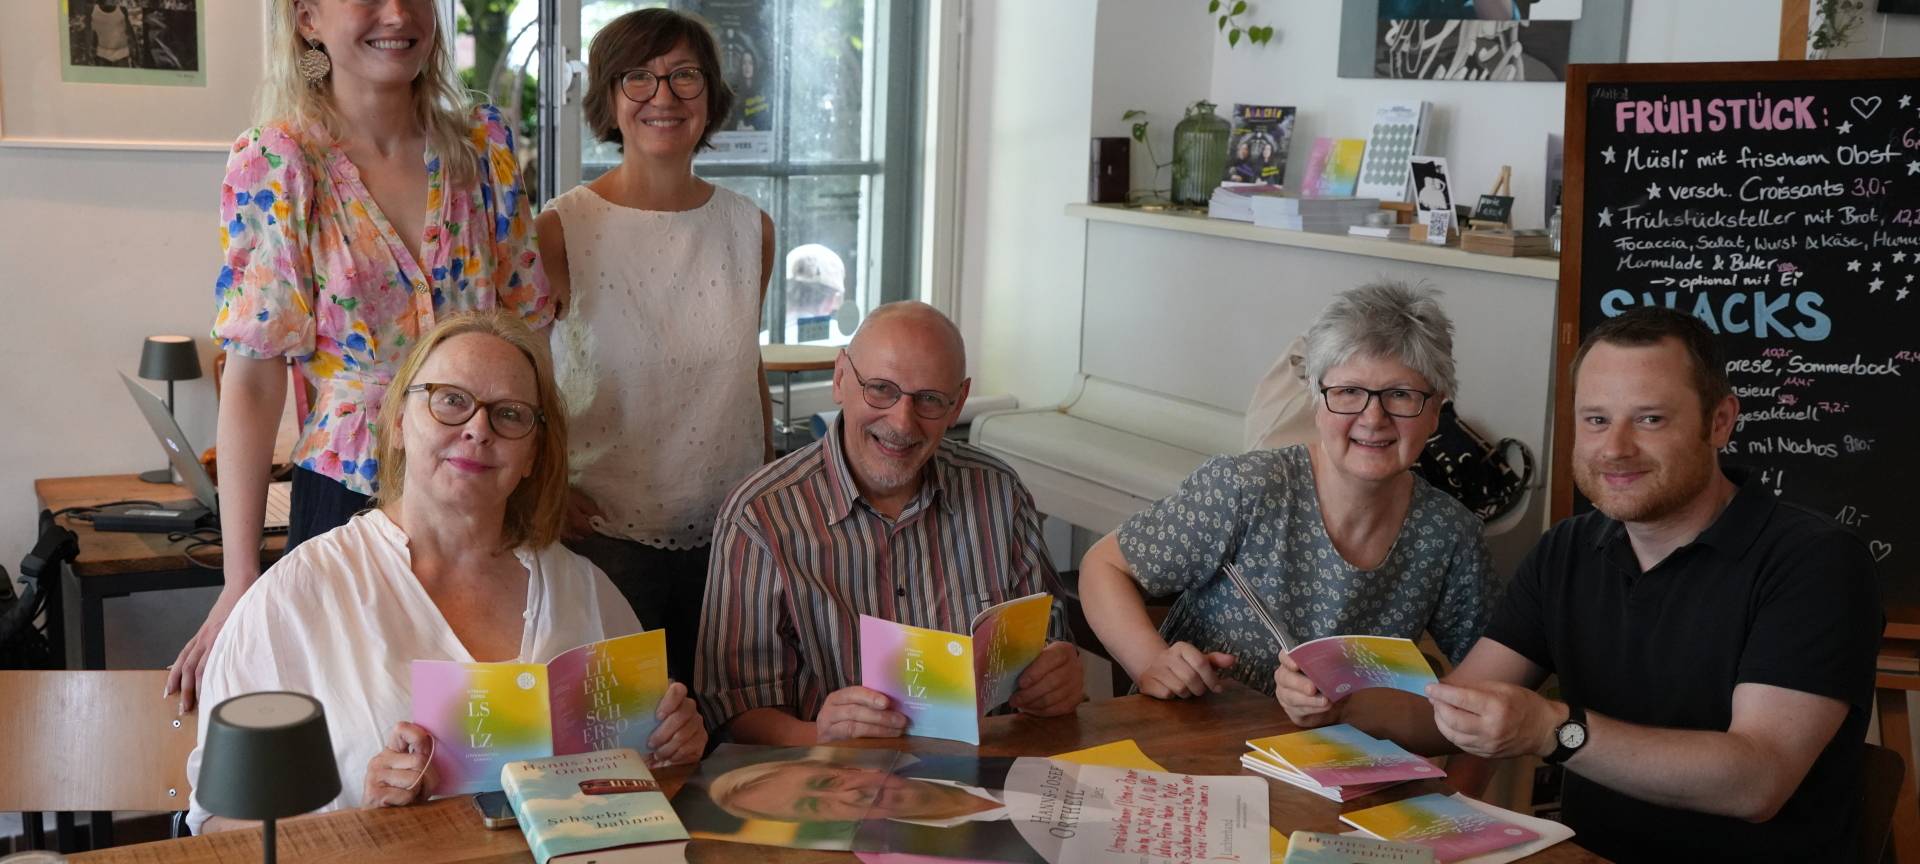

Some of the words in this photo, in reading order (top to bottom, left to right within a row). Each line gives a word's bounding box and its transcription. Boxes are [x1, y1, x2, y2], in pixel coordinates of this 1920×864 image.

[1625, 146, 1688, 172] Müsli
[1697, 149, 1728, 167] mit
[1736, 146, 1830, 168] frischem
[1837, 144, 1902, 165] Obst
[1668, 182, 1732, 200] versch.
[1739, 176, 1844, 201] Croissants
[1617, 205, 1796, 229] Frühstücksteller
[1804, 209, 1834, 225] mit
[1838, 206, 1885, 226] Brot,
[1613, 236, 1693, 252] Focaccia,
[1696, 235, 1750, 252] Salat,
[1755, 235, 1797, 249] Wurst
[1617, 254, 1703, 271] Marmelade
[1729, 253, 1778, 271] Butter
[1679, 273, 1738, 293] optional
[1743, 274, 1770, 285] mit
[1780, 271, 1803, 287] Ei
[1786, 354, 1901, 376] Sommerbock
[1749, 437, 1773, 454] mit
[1777, 436, 1839, 458] Nachos
[586, 657, 615, 678] LIT
[906, 658, 925, 672] LS
[584, 673, 619, 695] ERA
[908, 685, 927, 698] LZ
[468, 701, 491, 717] LS
[594, 690, 611, 709] RI
[586, 703, 622, 726] SCH
[470, 733, 493, 749] LZ
[583, 719, 629, 744] ERSO
[555, 762, 618, 776] Ortheil
[547, 811, 627, 826] Schwebe
[596, 814, 665, 830] bahnen
[1049, 790, 1085, 839] ORTHEIL
